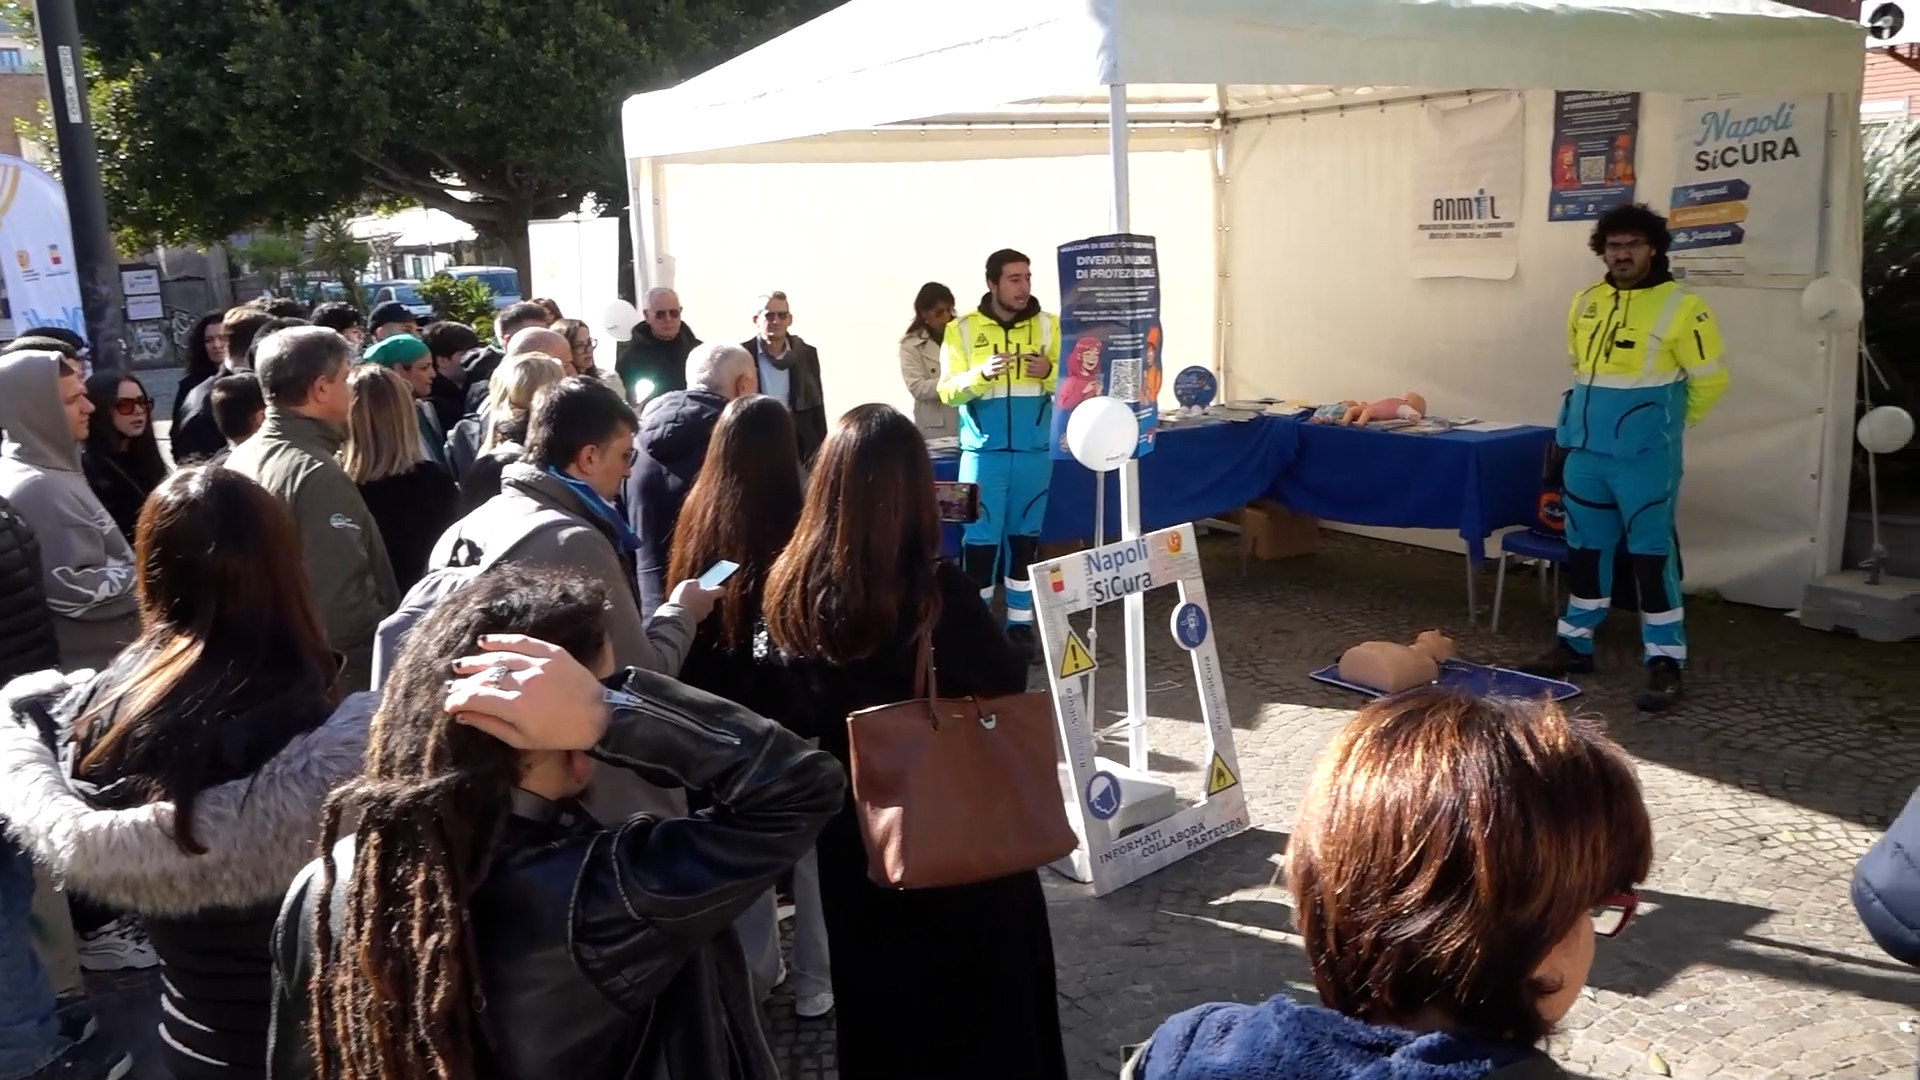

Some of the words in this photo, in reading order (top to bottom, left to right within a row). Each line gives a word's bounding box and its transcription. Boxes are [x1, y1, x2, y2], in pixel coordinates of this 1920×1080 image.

[1693, 102, 1796, 147] Napoli
[1695, 136, 1801, 172] SiCURA
[1075, 268, 1089, 279] DI
[1076, 255, 1123, 266] DIVENTA
[1086, 538, 1149, 575] Napoli
[1093, 571, 1153, 602] SiCura
[1099, 829, 1162, 864] INFORMATI
[1141, 822, 1206, 858] COLLABORA
[1186, 817, 1243, 850] PARTECIPA
